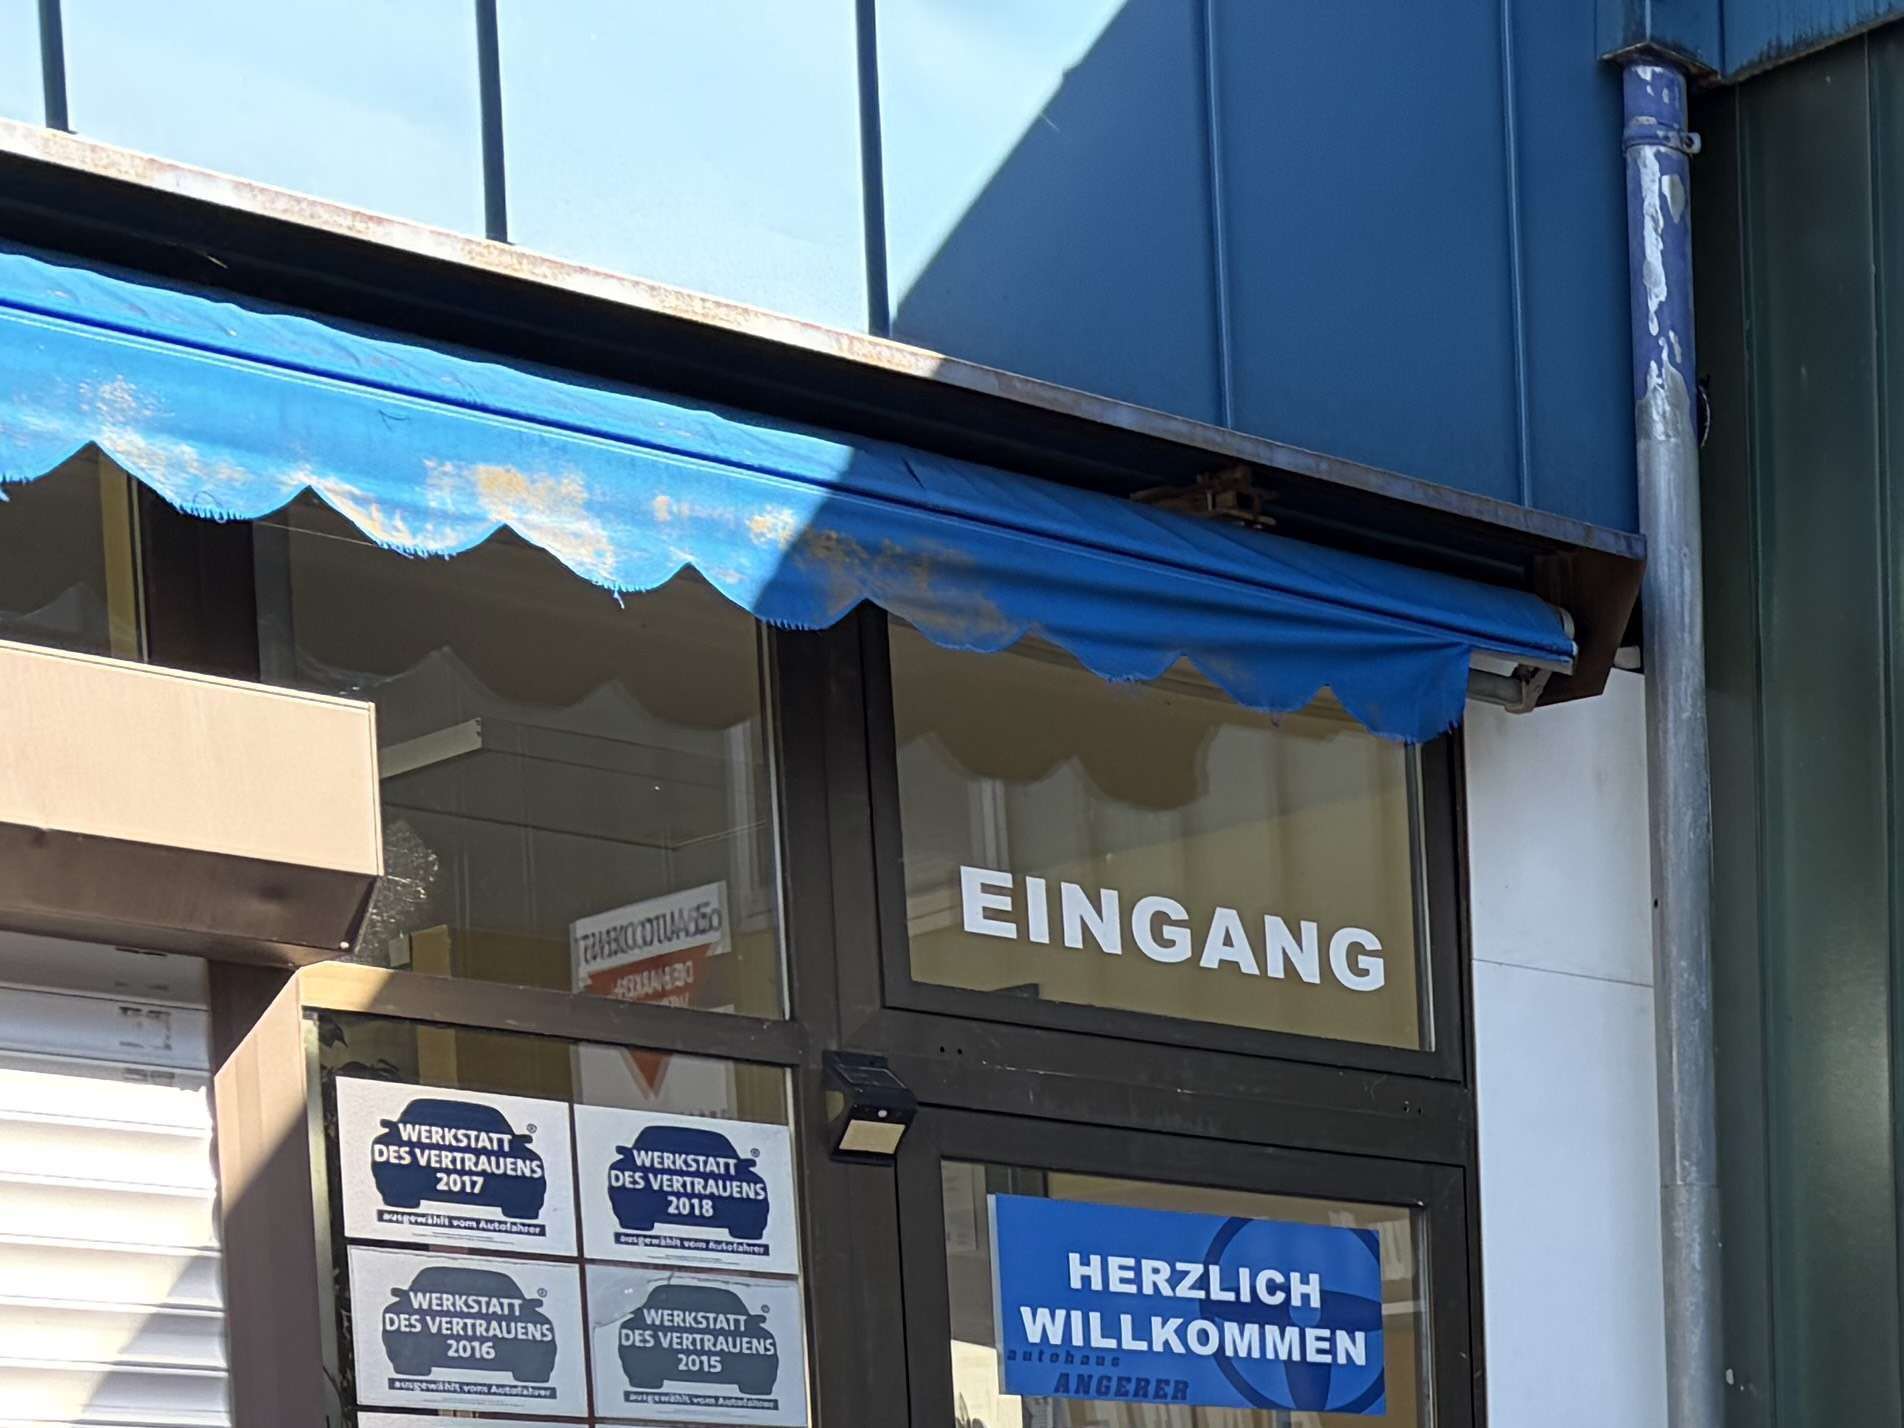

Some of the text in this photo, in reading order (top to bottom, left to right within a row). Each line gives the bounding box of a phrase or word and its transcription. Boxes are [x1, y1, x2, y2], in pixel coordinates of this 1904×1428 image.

[959, 864, 1386, 993] EINGANG
[398, 1123, 512, 1151] WERKSTATT
[374, 1144, 542, 1178] DES VERTRAUENS
[633, 1149, 737, 1176] WERKSTATT
[436, 1173, 484, 1194] 2017
[611, 1170, 766, 1199] DES VERTRAUENS
[667, 1196, 714, 1216] 2018
[1068, 1252, 1321, 1308] HERZLICH
[409, 1291, 522, 1316] WERKSTATT
[384, 1313, 552, 1341] DES VERTRAUENS
[643, 1308, 747, 1331] WERKSTATT
[446, 1340, 495, 1359] 2016
[621, 1329, 774, 1354] DES VERTRAUENS
[1020, 1306, 1366, 1366] WILLKOMMEN
[678, 1354, 722, 1372] 2015
[1008, 1349, 1120, 1367] autohaus
[1054, 1372, 1189, 1400] ANGERER
